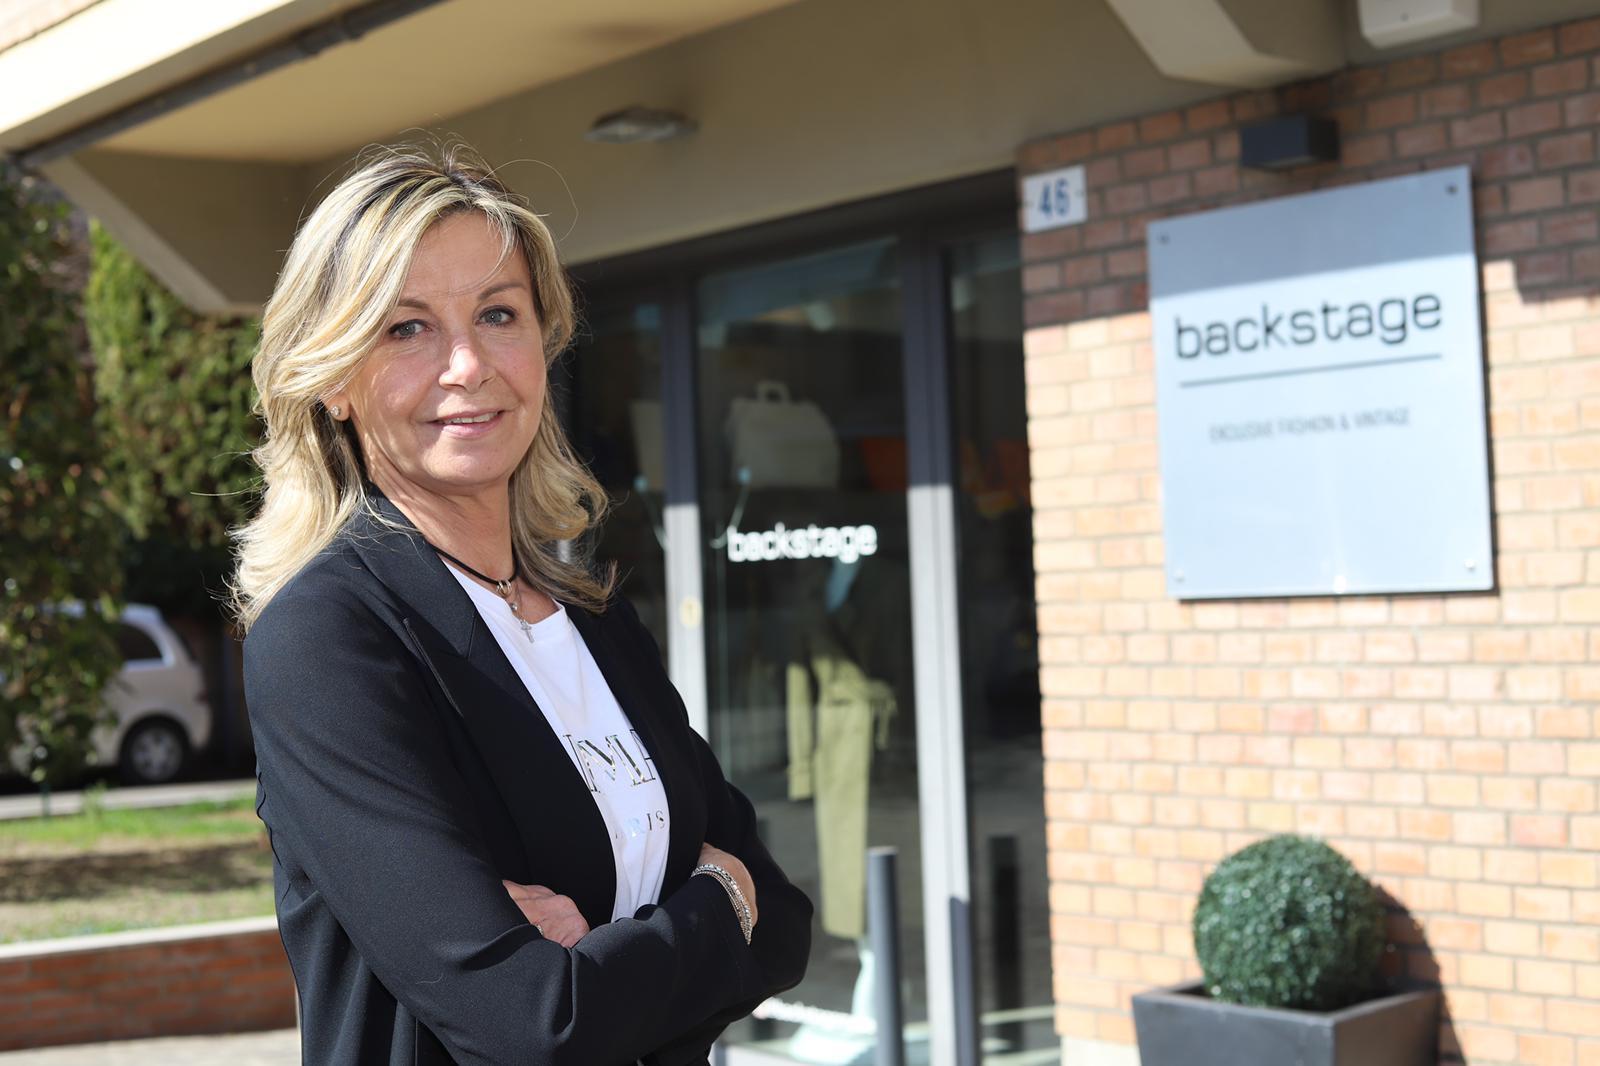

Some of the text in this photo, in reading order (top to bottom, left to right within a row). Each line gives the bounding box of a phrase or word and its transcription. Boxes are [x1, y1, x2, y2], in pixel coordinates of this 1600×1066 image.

[1038, 179, 1071, 218] 46
[1174, 293, 1442, 360] backstage
[727, 522, 877, 563] backstage
